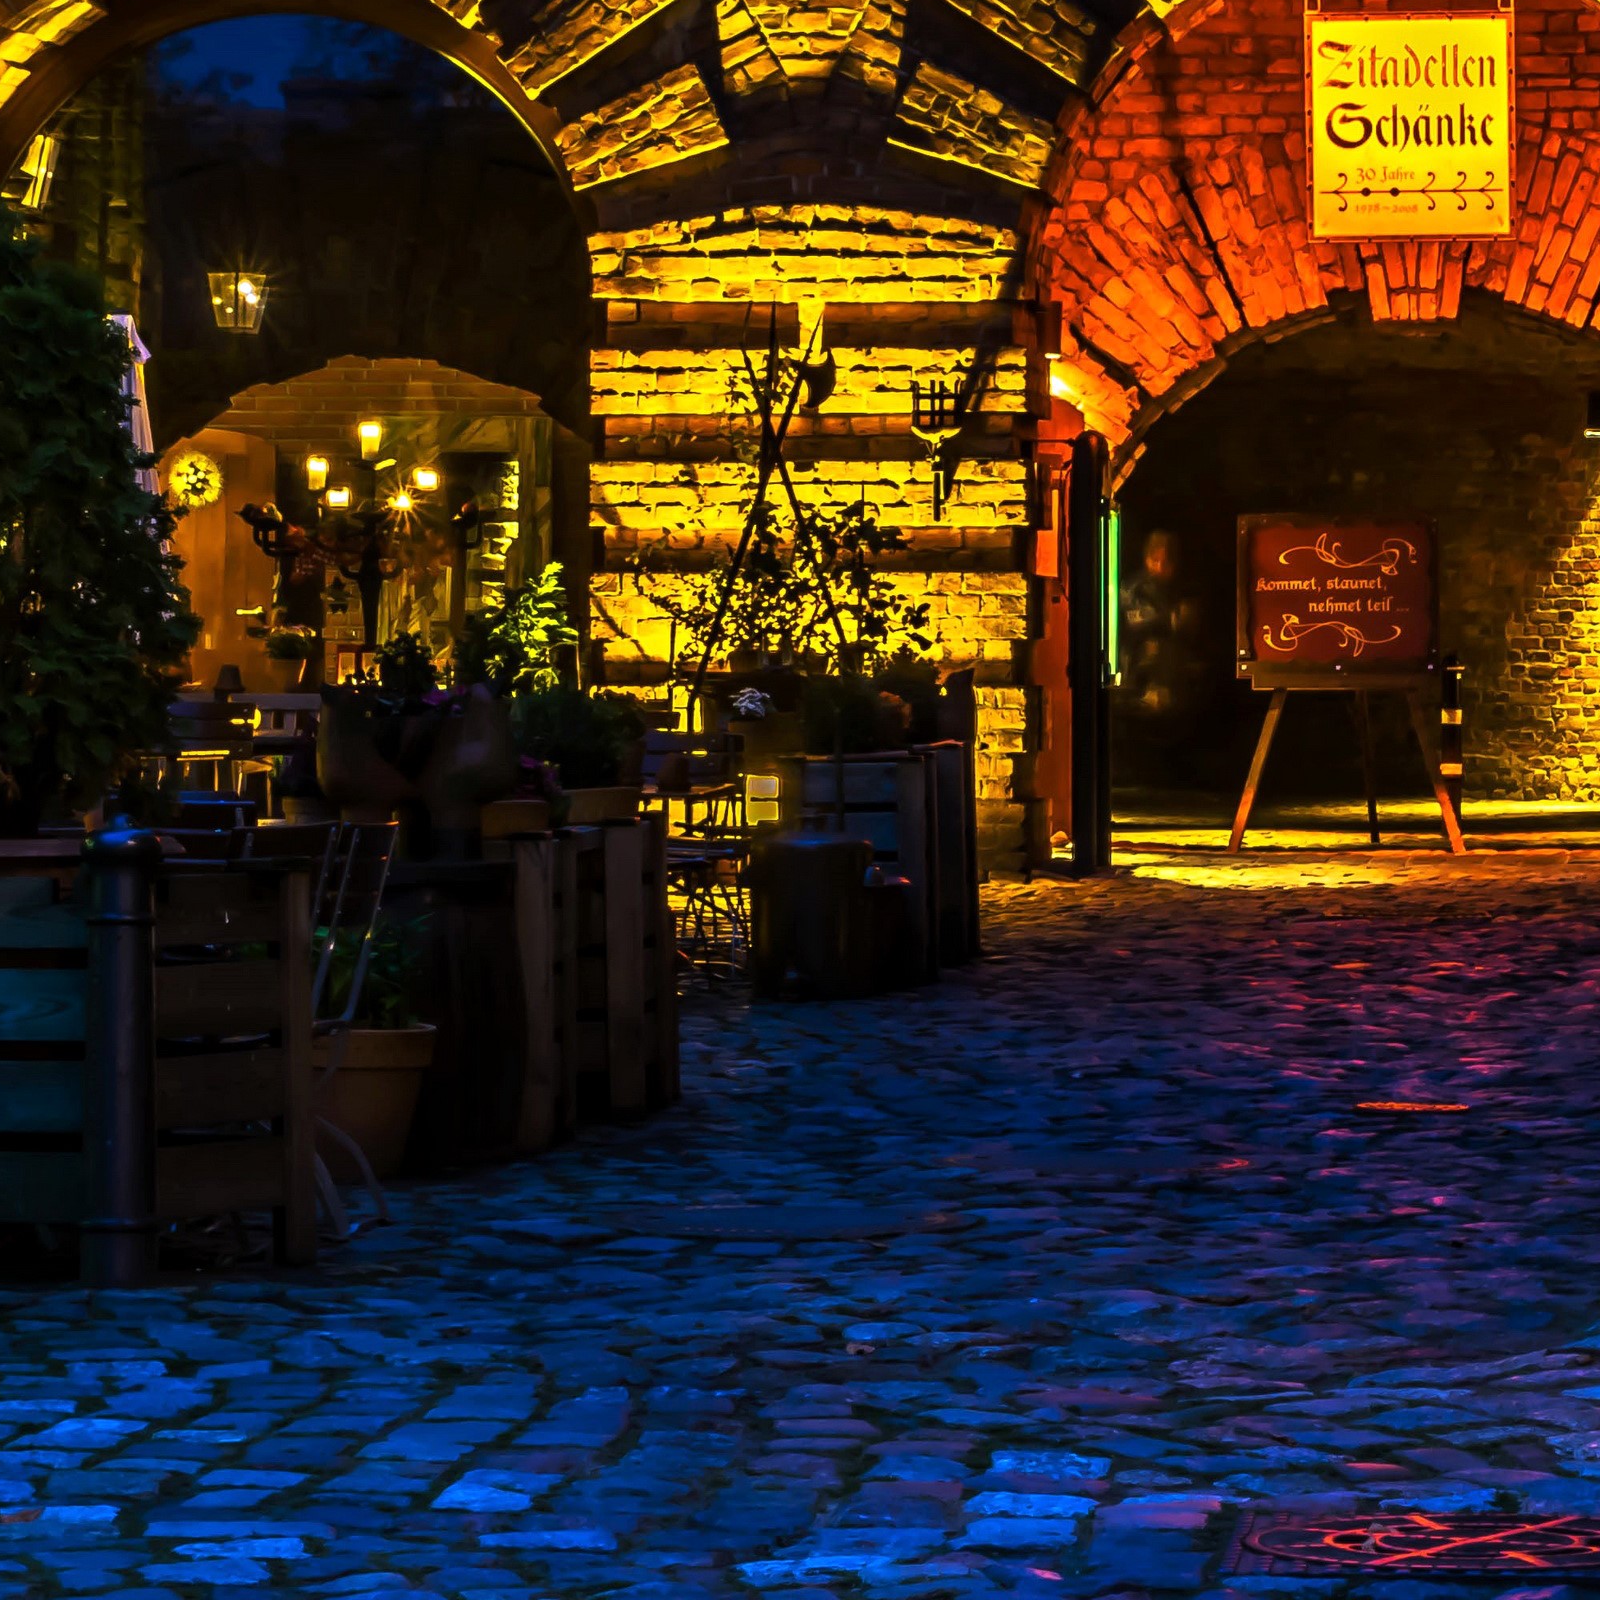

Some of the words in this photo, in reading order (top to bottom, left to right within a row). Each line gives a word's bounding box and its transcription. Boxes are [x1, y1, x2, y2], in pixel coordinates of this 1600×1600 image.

[1317, 40, 1497, 89] Zitadellen
[1325, 102, 1494, 152] Schänke
[1356, 167, 1376, 184] 30
[1380, 166, 1415, 183] Jahre
[1308, 596, 1362, 615] nehmet
